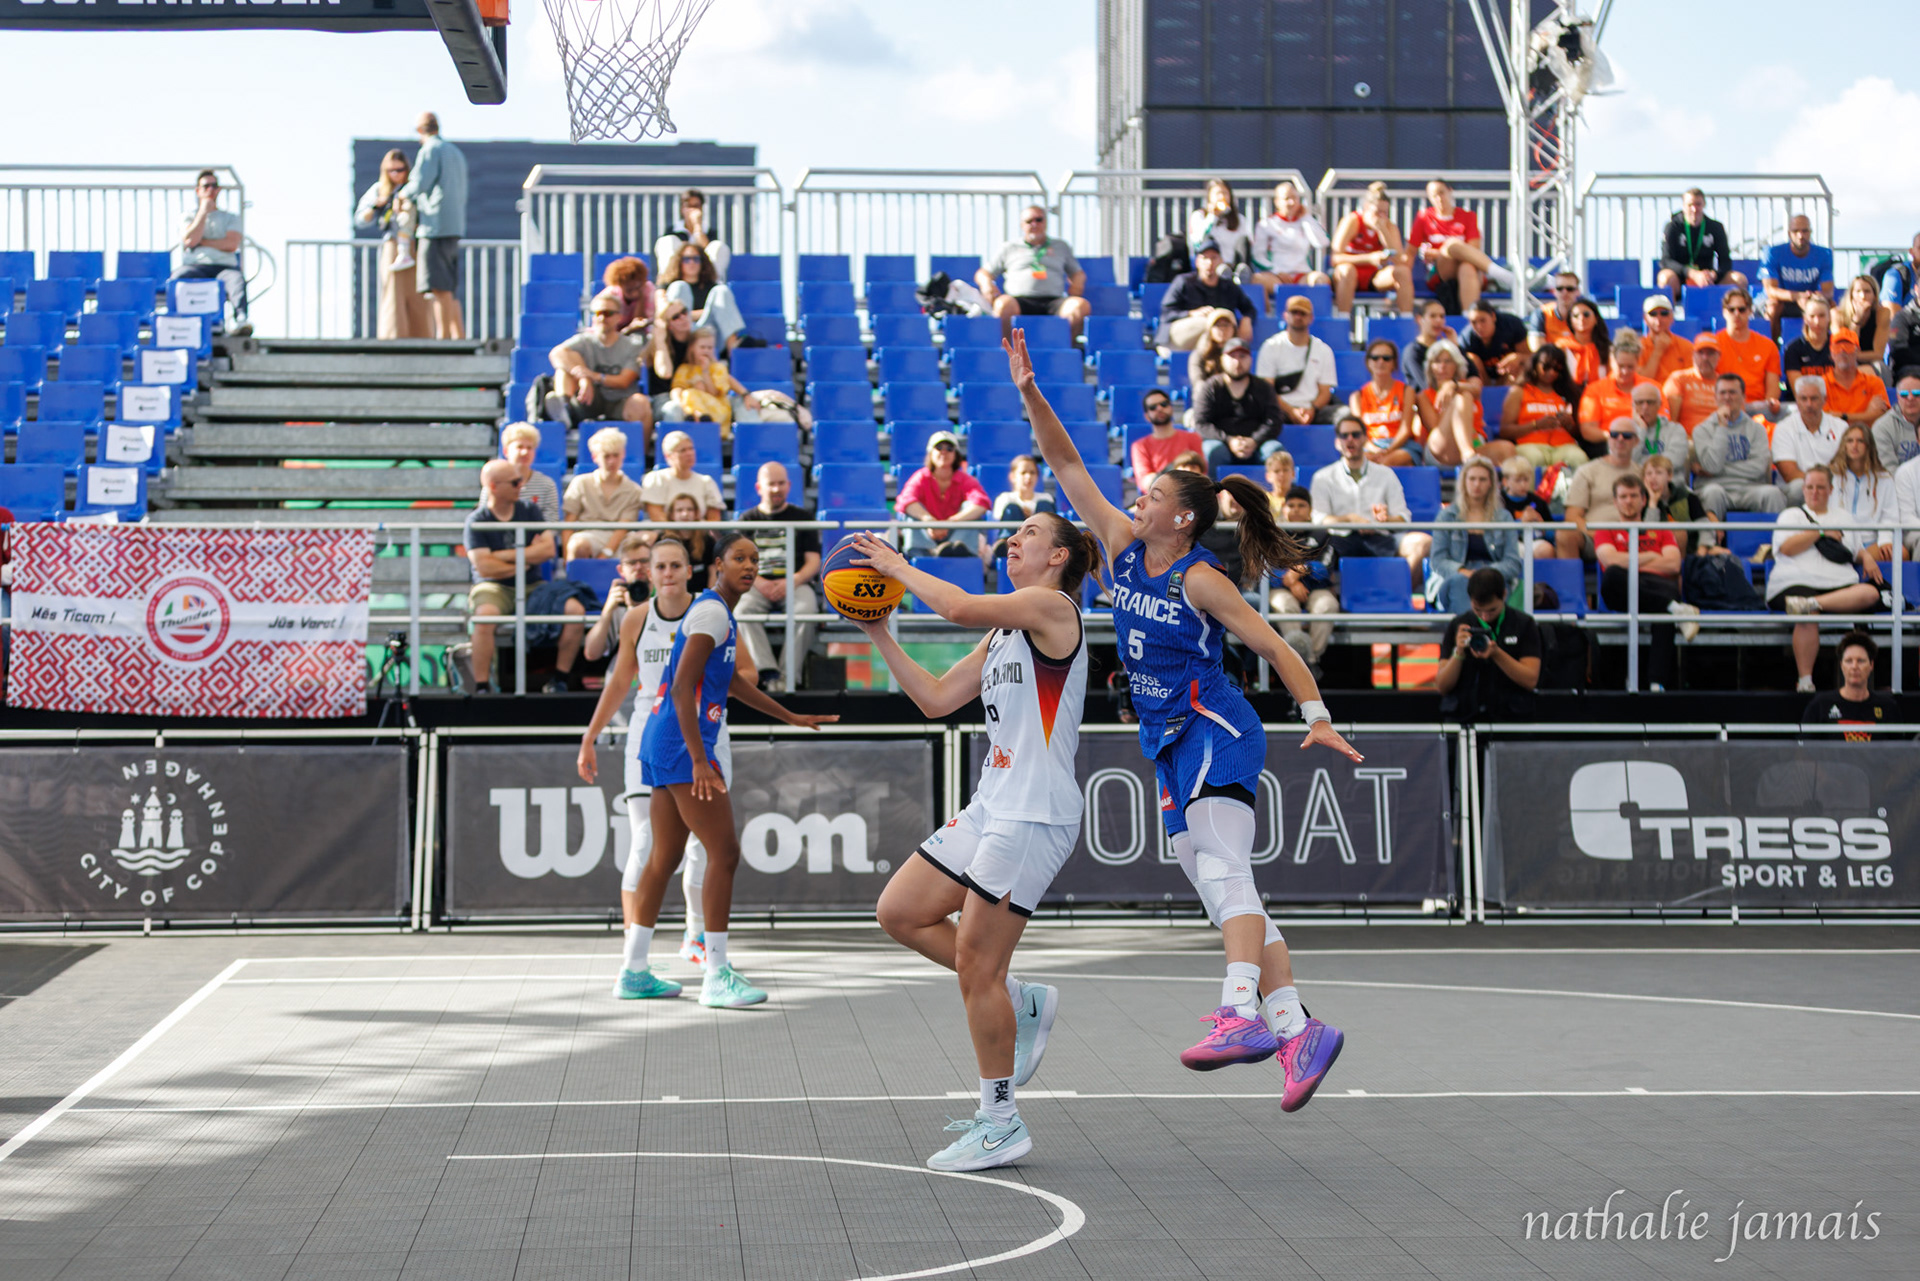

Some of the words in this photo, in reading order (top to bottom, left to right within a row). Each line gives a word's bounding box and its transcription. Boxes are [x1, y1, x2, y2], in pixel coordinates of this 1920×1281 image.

[1113, 582, 1183, 625] FRANCE
[1128, 628, 1146, 660] 5
[1127, 671, 1161, 686] AISSE
[122, 759, 228, 890] COPENHAGEN
[1639, 817, 1892, 860] TRESS
[80, 853, 128, 900] CITY
[1721, 865, 1808, 888] SPORT
[1818, 865, 1837, 887] &
[1847, 865, 1894, 887] LEG
[140, 887, 174, 906] OF
[994, 1080, 1009, 1104] PEAK
